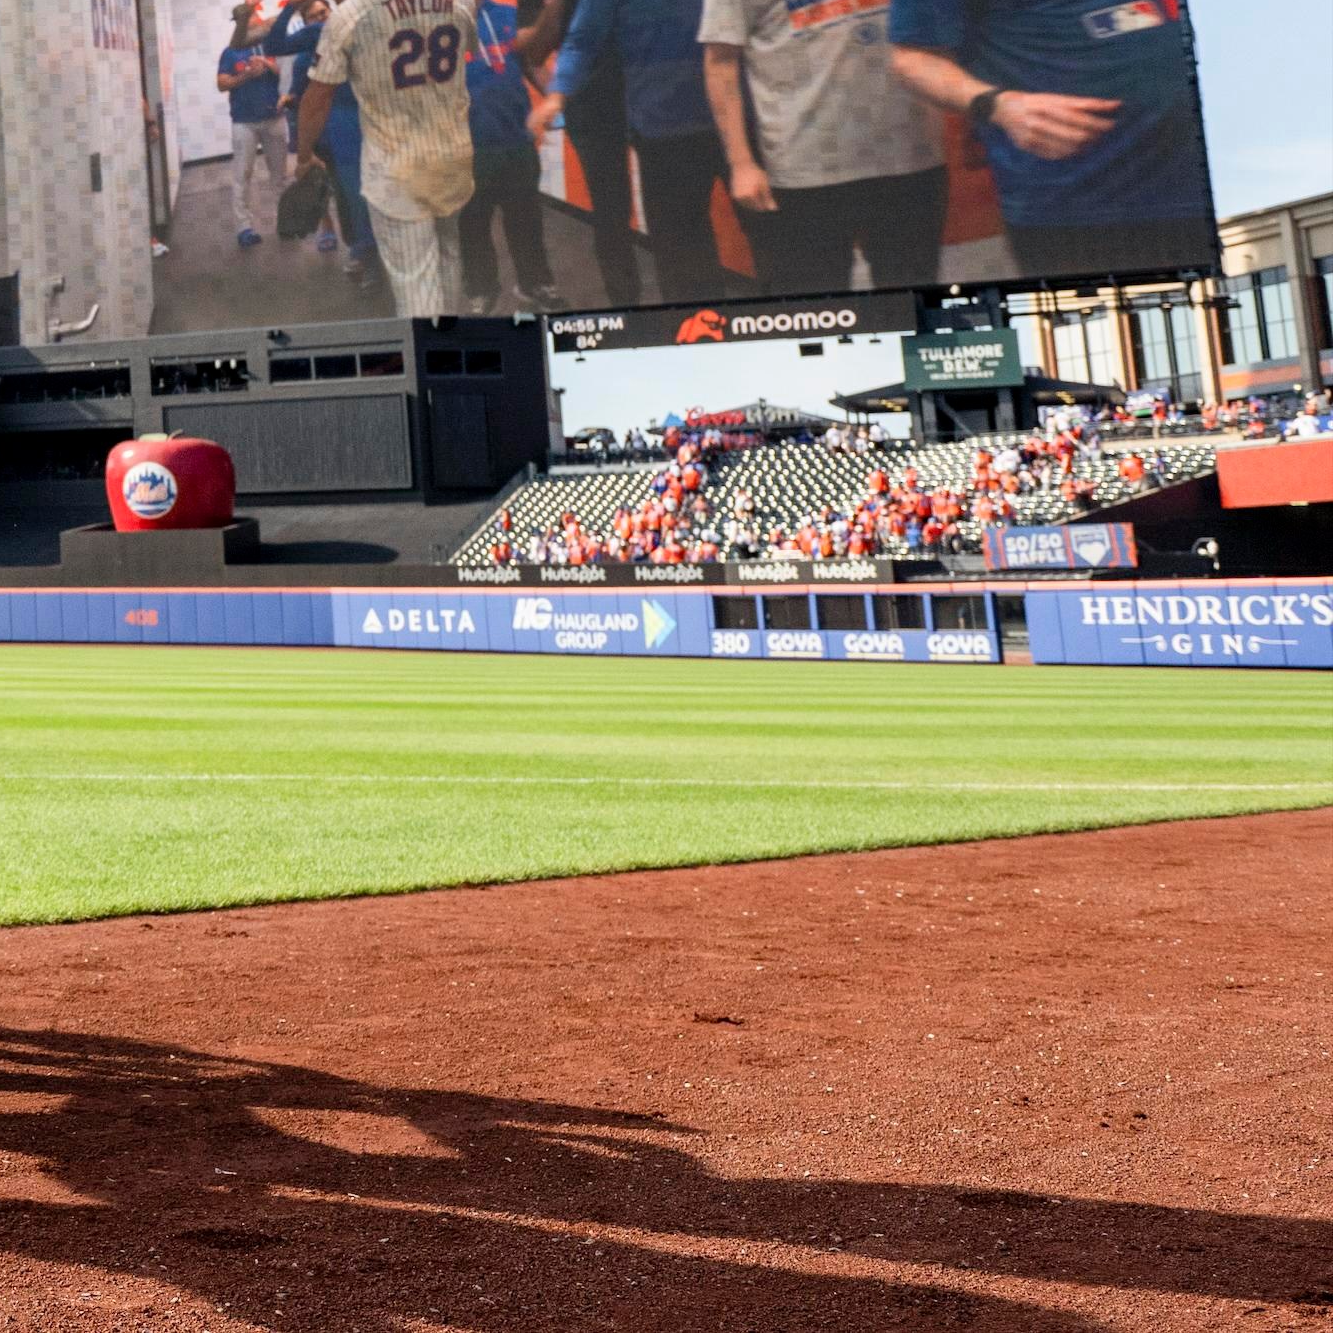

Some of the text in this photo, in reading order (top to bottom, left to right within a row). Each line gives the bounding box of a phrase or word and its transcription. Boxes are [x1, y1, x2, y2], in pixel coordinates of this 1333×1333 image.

[388, 26, 461, 90] 28
[553, 316, 624, 335] 04:55 PM
[731, 309, 857, 335] moomoo
[918, 344, 1004, 361] TULLAMORE
[1005, 535, 1063, 553] 50/50
[1007, 549, 1067, 567] RAFFLE
[457, 561, 878, 584] HubSpot HubSpot HubSpot HubSpot HubSpot
[388, 609, 475, 633] DELTA
[1080, 595, 1333, 627] HENDRICK'S
[553, 614, 639, 632] HAUGLAND
[555, 631, 607, 650] GROUP
[712, 632, 750, 655] 380
[1171, 633, 1244, 655] GIN
